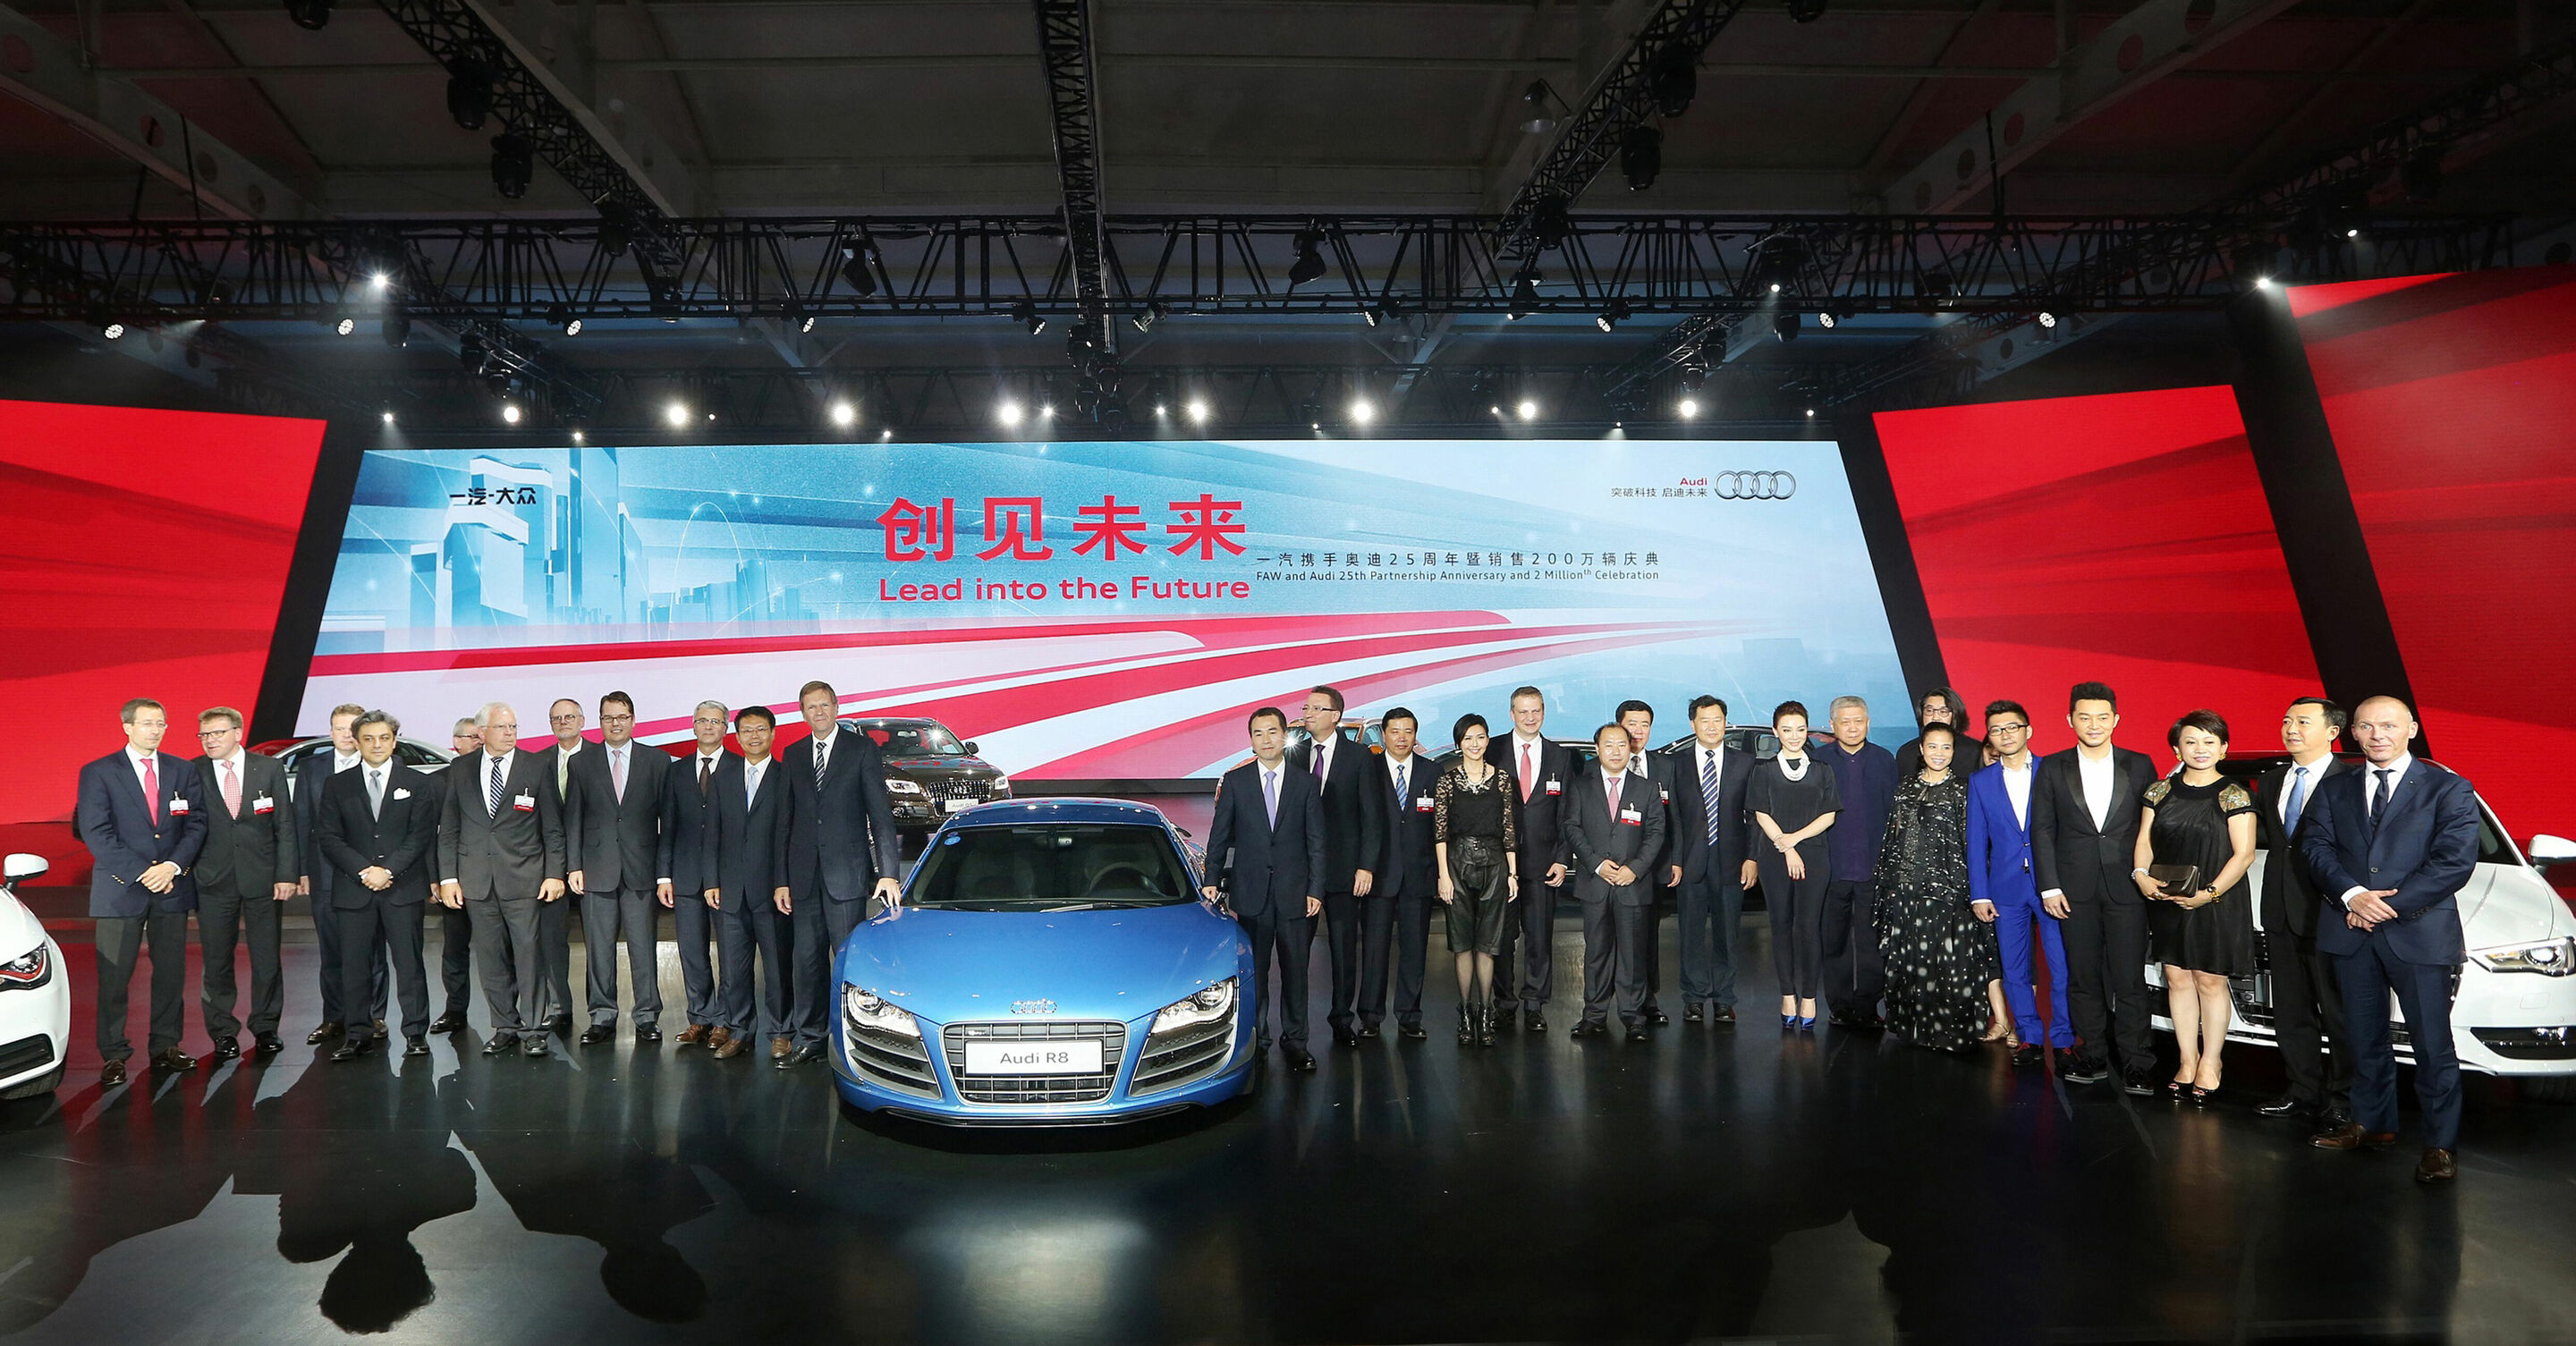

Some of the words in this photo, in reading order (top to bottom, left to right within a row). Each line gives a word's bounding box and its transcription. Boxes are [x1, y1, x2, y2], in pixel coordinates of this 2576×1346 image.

[1680, 478, 1707, 486] Audi
[449, 487, 536, 505] 一汽-大众
[1611, 487, 1657, 497] 突破科技
[1662, 487, 1707, 497] 启迪未来
[875, 494, 1248, 562] 创见未来
[1257, 552, 1659, 567] 一汽携手奥迪25周年暨销售200万辆庆典
[1256, 571, 1282, 580] FAW
[1285, 571, 1306, 580] and
[1309, 571, 1335, 580] Audi
[1339, 571, 1366, 580] 25th
[1370, 571, 1436, 582] Partnership
[1440, 570, 1506, 581] Anniversary
[1510, 570, 1530, 580] and
[1534, 571, 1540, 580] 2
[1595, 570, 1659, 580] Celebration
[879, 578, 962, 601] Lead
[976, 578, 1047, 600] into
[1059, 577, 1118, 599] the
[1131, 576, 1250, 599] Future
[1000, 1053, 1039, 1064] Audi
[1046, 1052, 1069, 1063] R8
